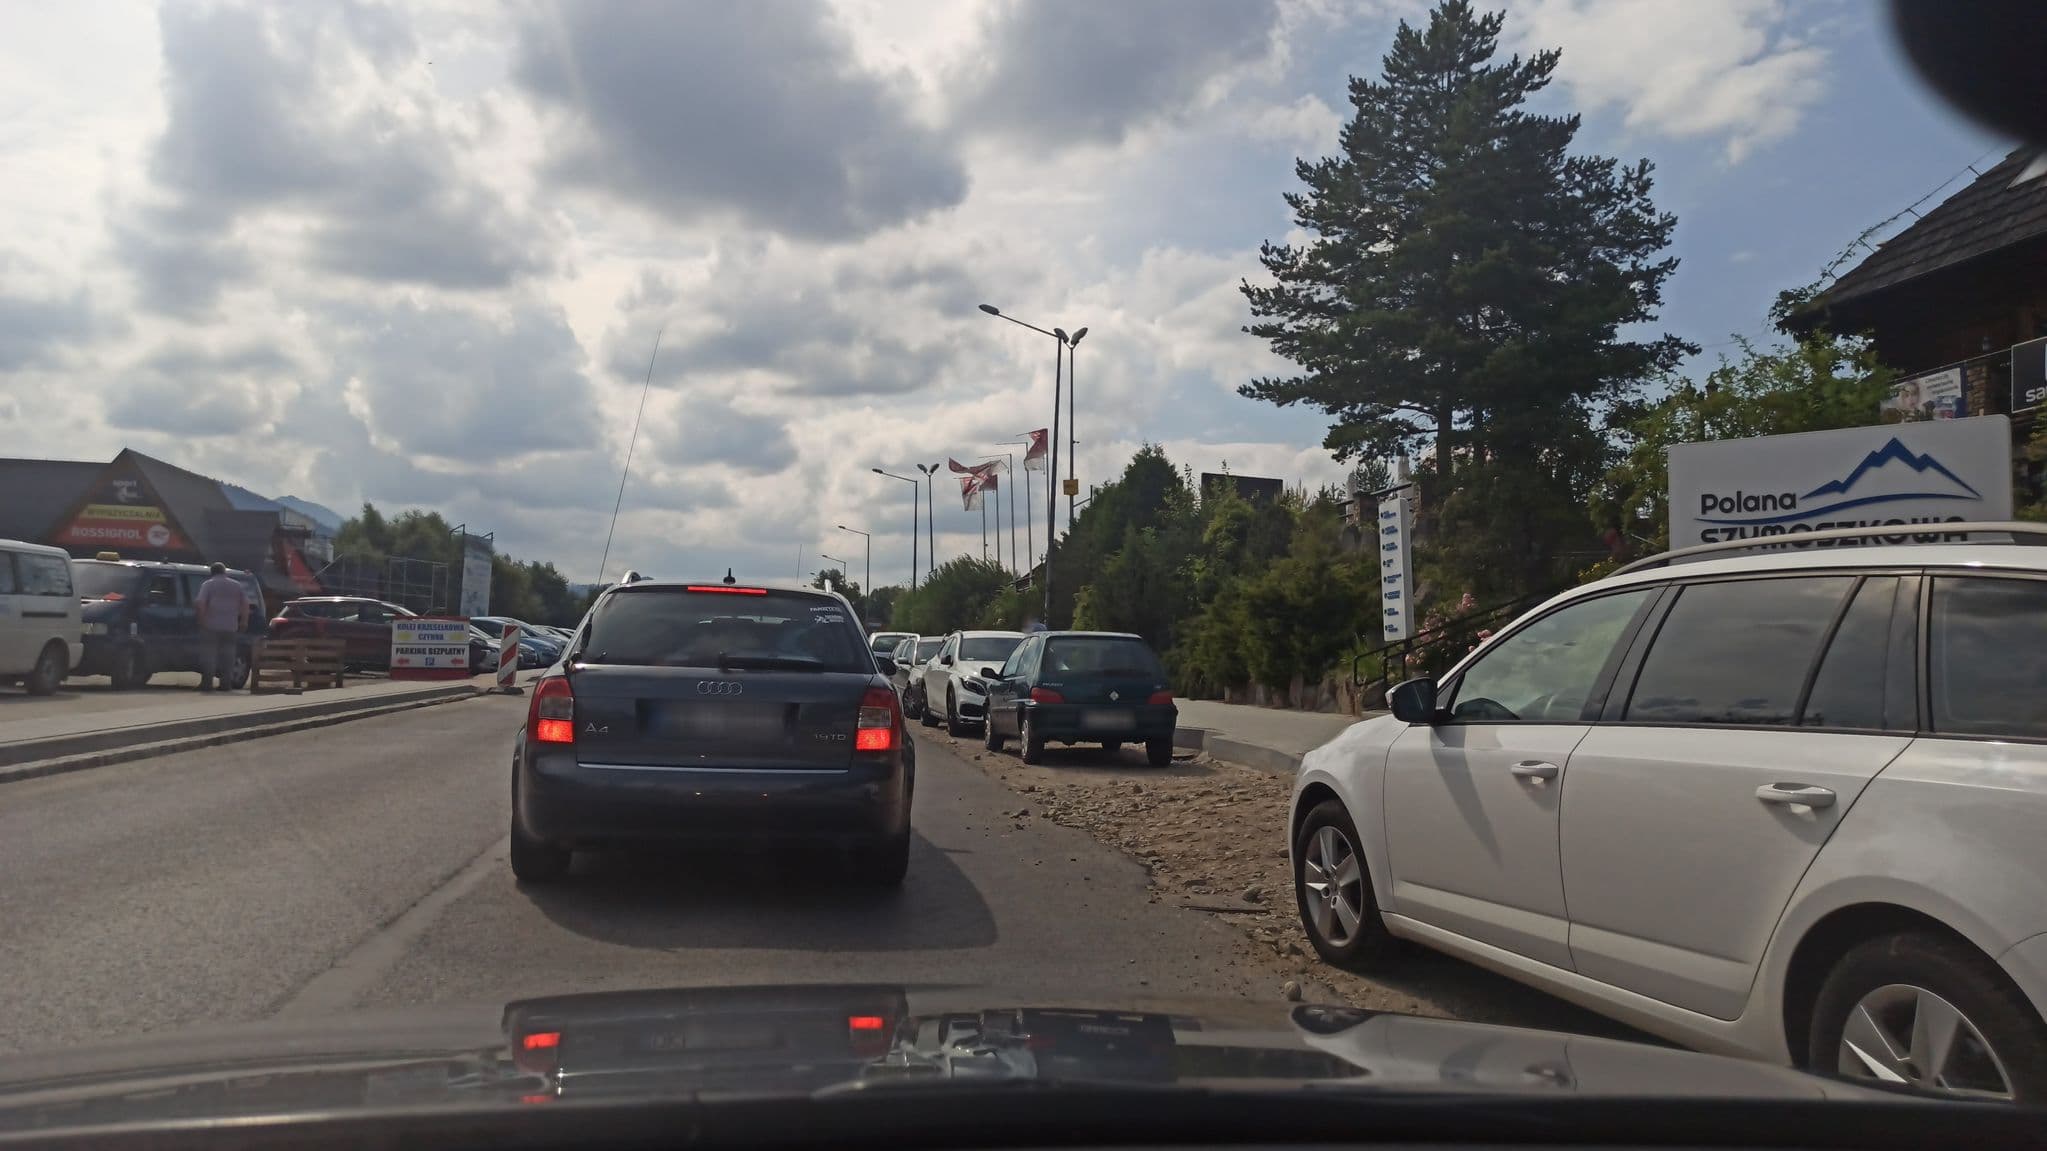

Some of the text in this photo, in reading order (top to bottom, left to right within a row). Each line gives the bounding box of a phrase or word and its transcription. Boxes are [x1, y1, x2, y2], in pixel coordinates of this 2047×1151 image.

[2025, 387, 2047, 403] sa
[1701, 491, 1797, 515] Polana
[71, 526, 142, 540] ROSSIGNOL
[396, 647, 466, 655] PARKING BEZPŁATNY
[584, 722, 609, 733] A4
